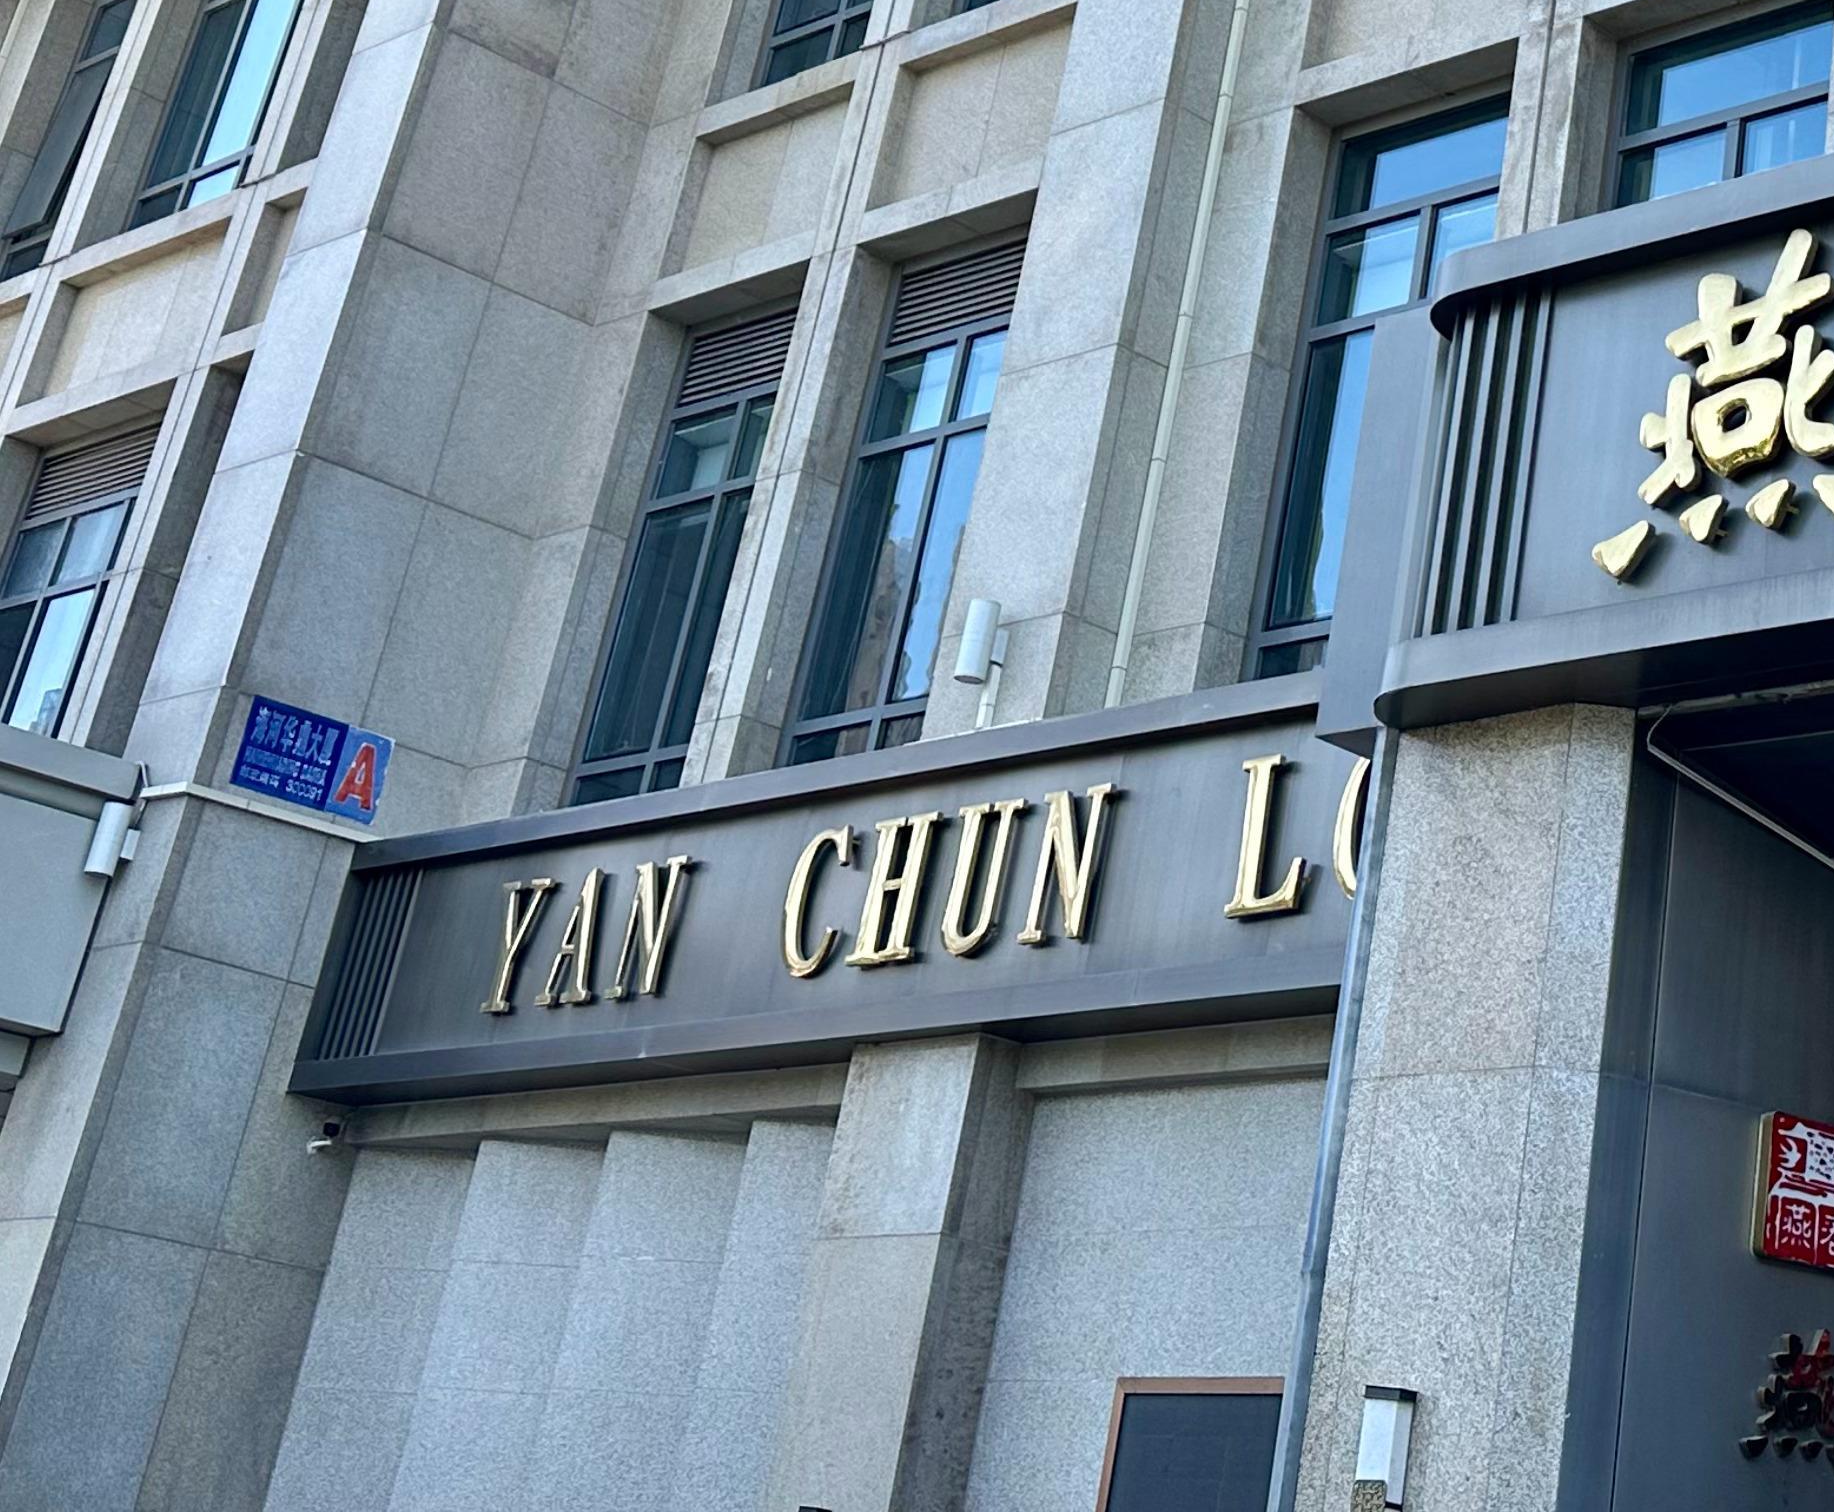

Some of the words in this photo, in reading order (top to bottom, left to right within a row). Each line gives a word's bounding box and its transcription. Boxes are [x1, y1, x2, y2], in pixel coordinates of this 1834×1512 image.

[333, 742, 376, 812] A
[480, 854, 690, 1015] YAN
[781, 781, 1118, 979] CHUN
